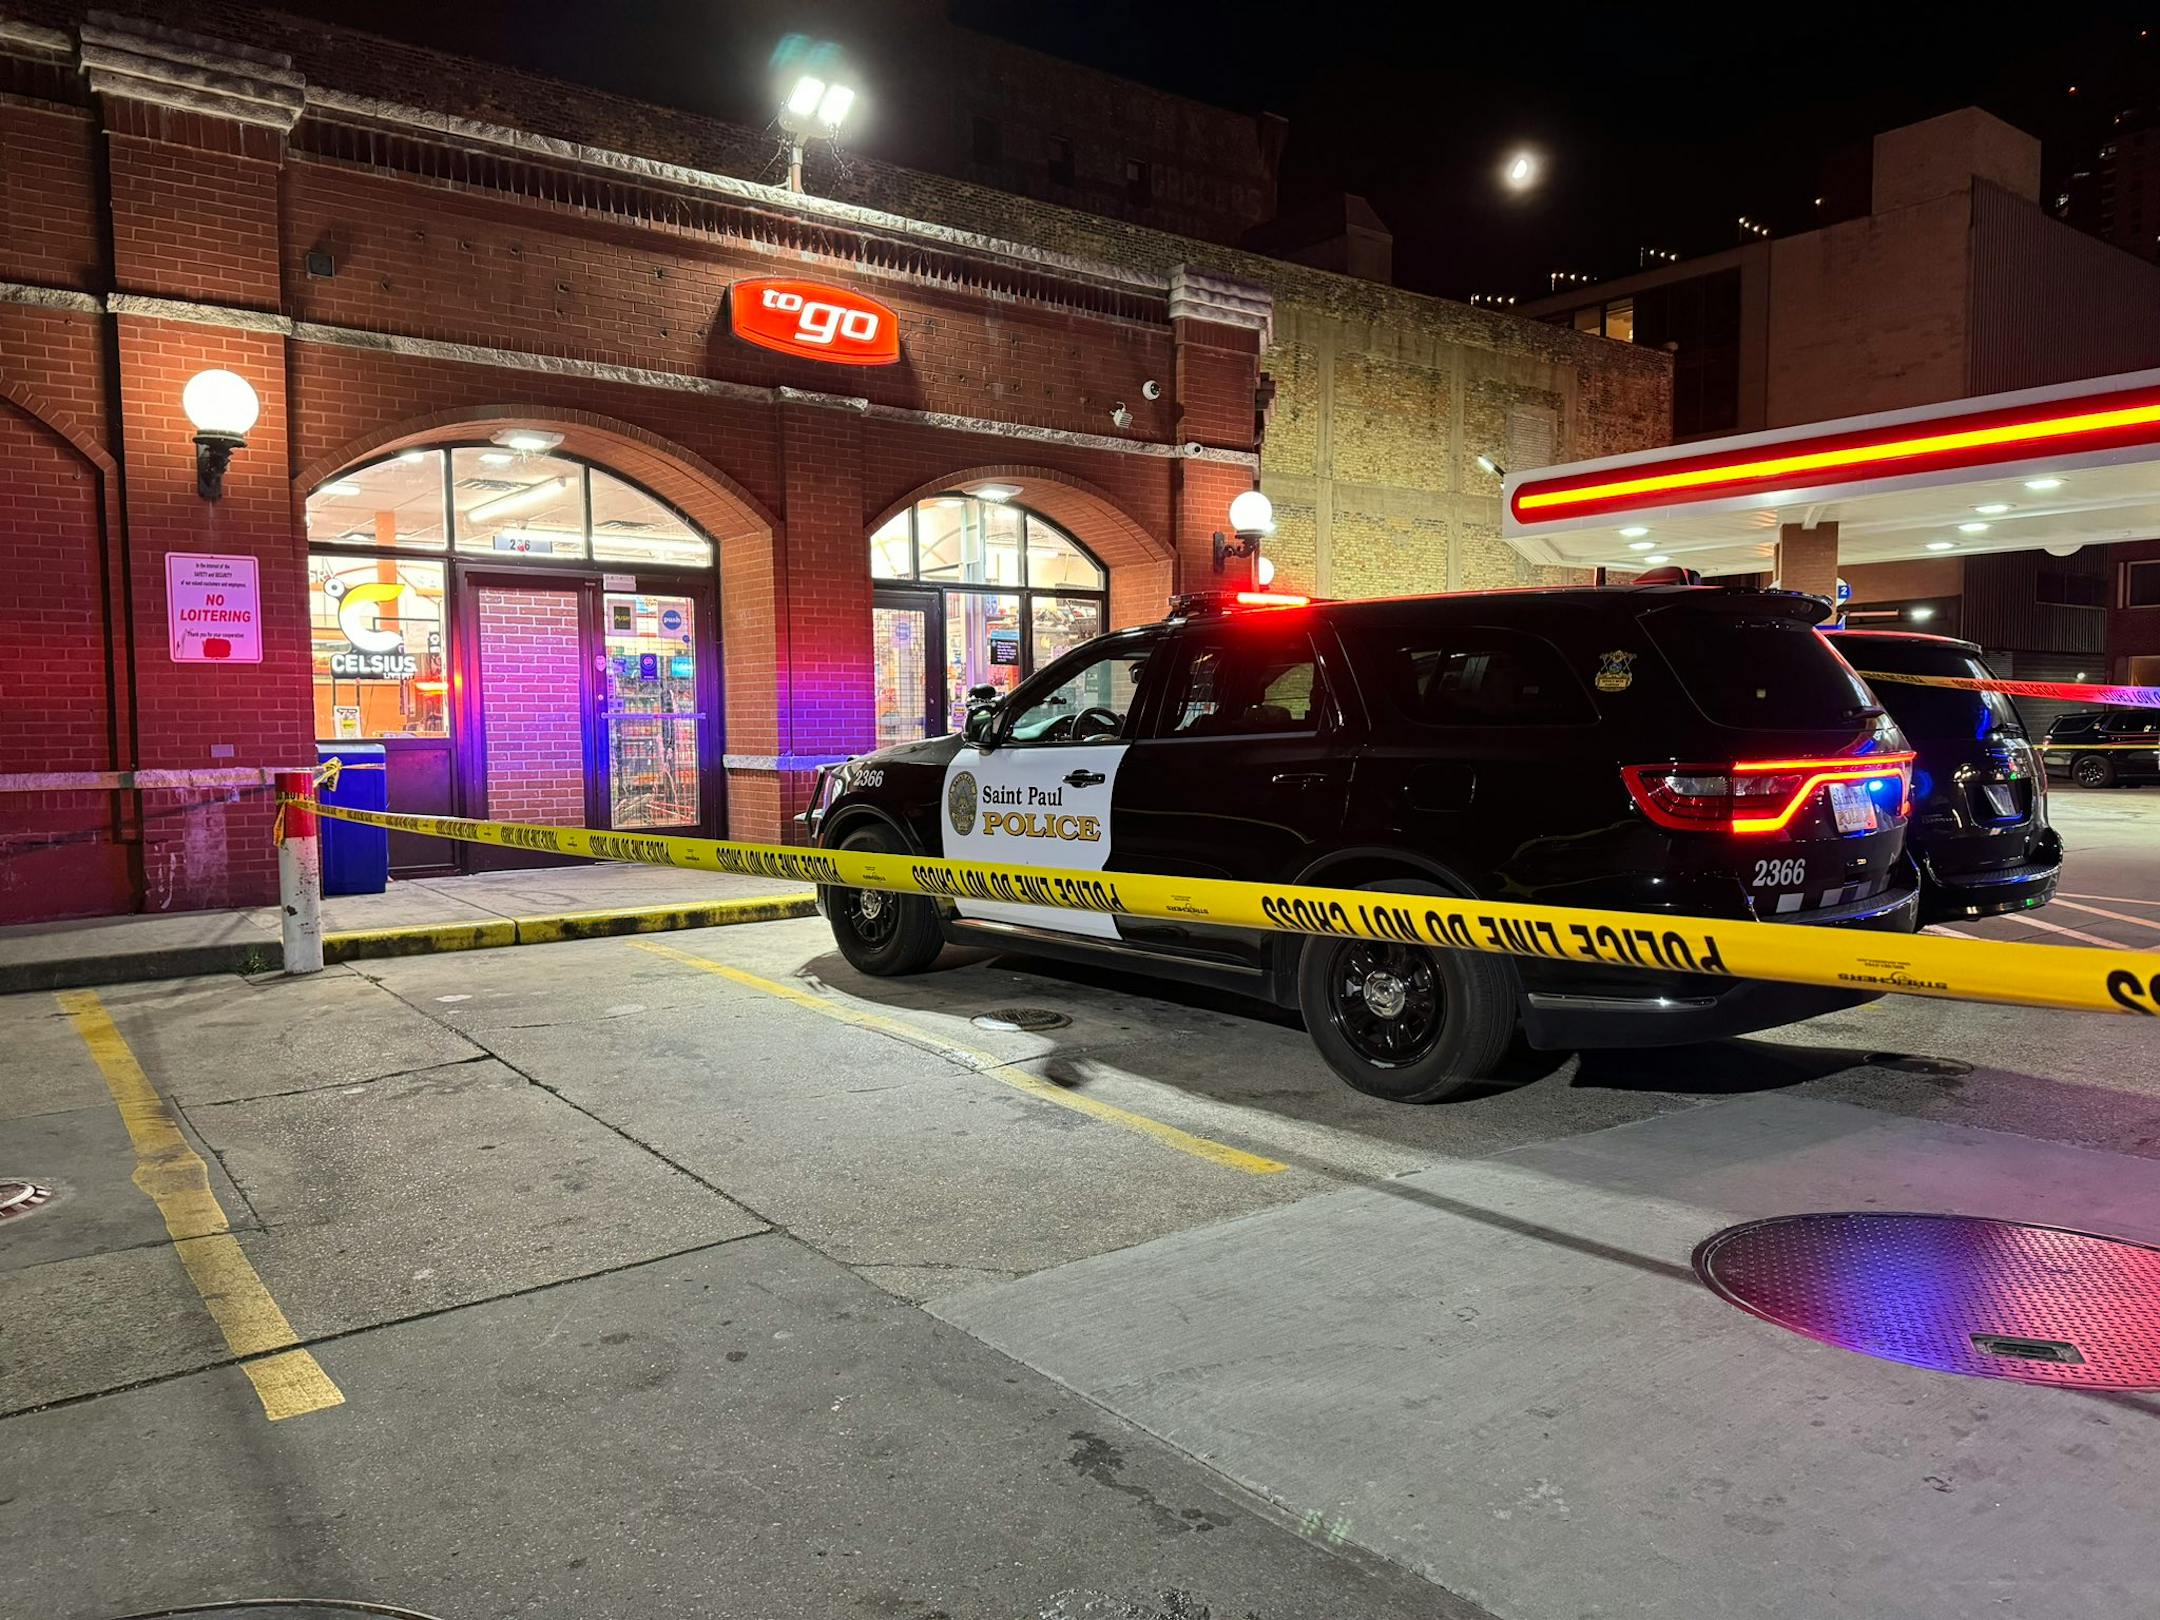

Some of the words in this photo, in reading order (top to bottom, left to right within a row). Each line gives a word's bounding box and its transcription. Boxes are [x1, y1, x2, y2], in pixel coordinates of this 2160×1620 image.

[762, 289, 803, 312] to
[794, 301, 880, 344] go
[206, 594, 225, 606] NO
[1841, 587, 1848, 595] 2
[180, 609, 251, 622] LOITERING
[331, 654, 416, 673] CELSIUS
[853, 769, 884, 787] 2366
[983, 785, 1023, 805] Saint
[1028, 786, 1063, 806] Paul
[982, 812, 1101, 842] POLICE
[716, 847, 753, 875] CROSS
[778, 853, 811, 880] LINE
[801, 855, 847, 884] POLICE
[1752, 858, 1806, 887] 2366
[912, 865, 967, 897] CROSS
[960, 869, 999, 900] NOT
[990, 871, 1024, 902] DO
[1014, 874, 1067, 907] LINE
[1054, 878, 1130, 913] POLICE
[1262, 896, 1362, 937] CROSS
[1358, 904, 1429, 944] NOT
[1424, 910, 1483, 950] DO
[1478, 916, 1571, 960] LINE
[1568, 923, 1733, 976] POLICE
